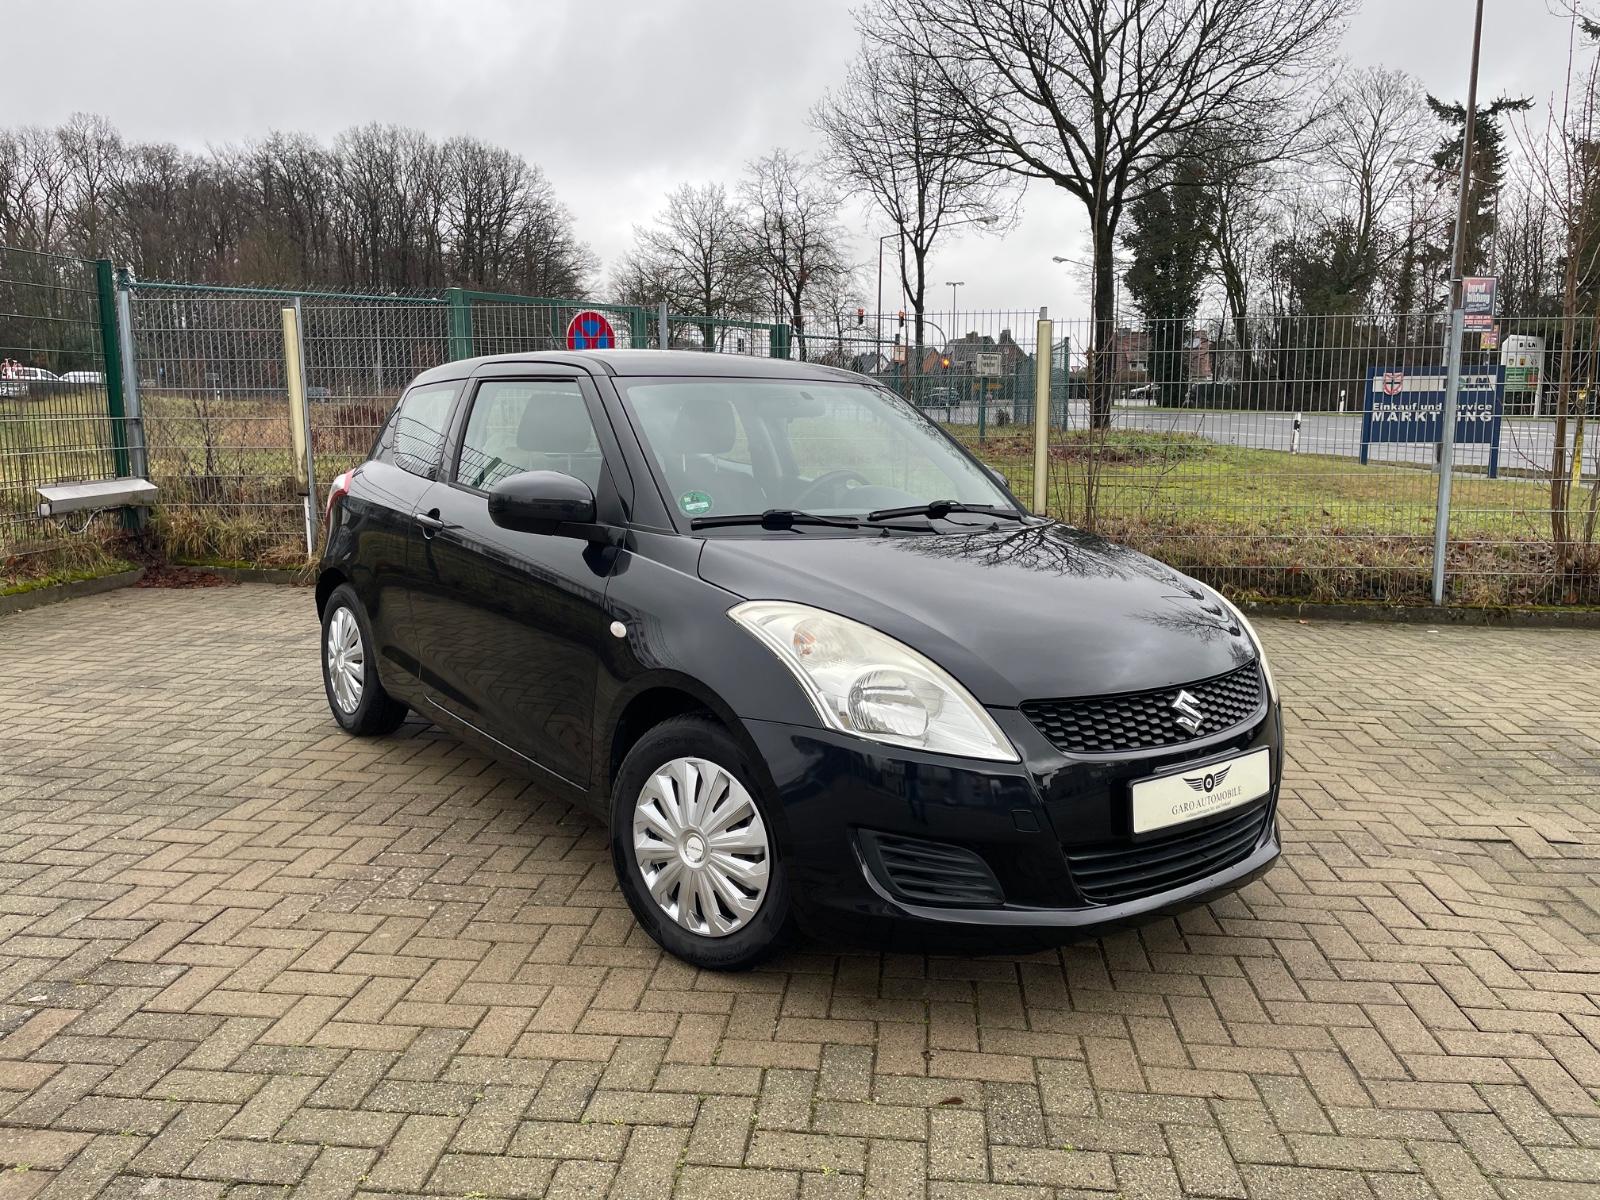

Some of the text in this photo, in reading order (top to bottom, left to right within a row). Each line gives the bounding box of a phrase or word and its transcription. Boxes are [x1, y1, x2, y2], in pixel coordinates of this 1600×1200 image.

[1373, 402, 1493, 411] Einkauf und ervice
[1372, 411, 1493, 422] MARKTING
[1171, 801, 1195, 816] GARO
[1195, 785, 1242, 808] AUTOMOBILE
